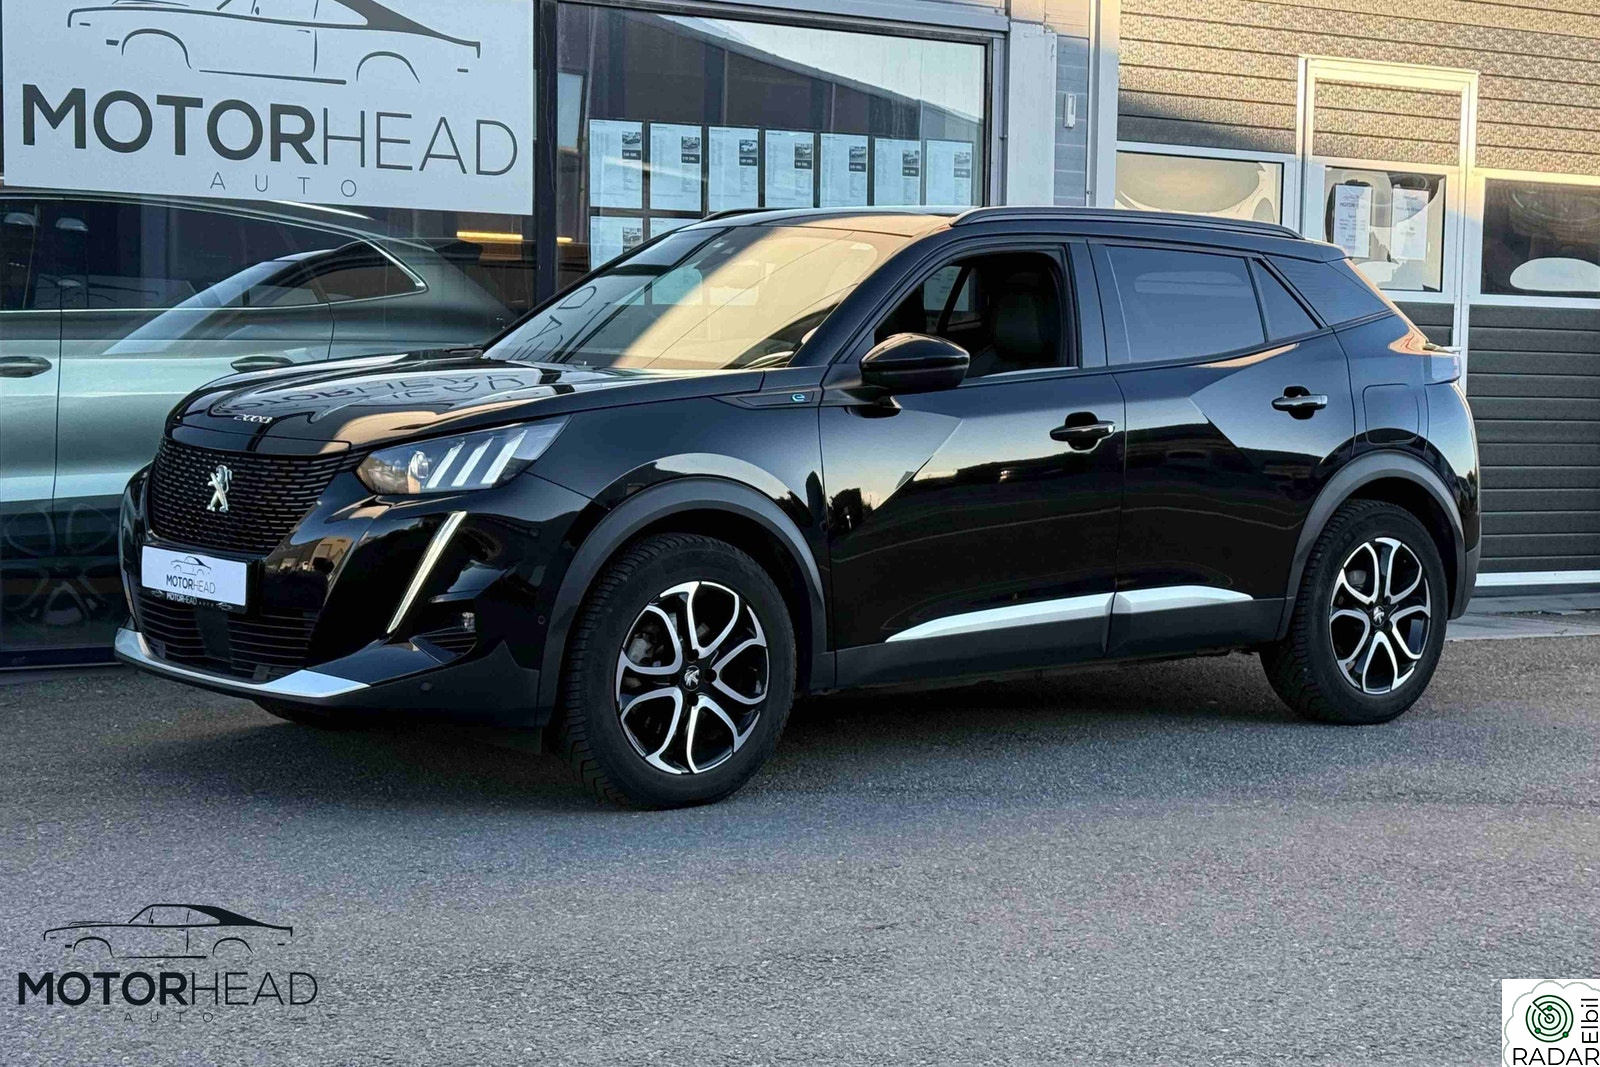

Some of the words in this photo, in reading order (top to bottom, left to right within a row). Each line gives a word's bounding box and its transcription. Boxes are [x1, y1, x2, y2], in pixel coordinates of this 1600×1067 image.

[22, 83, 518, 177] MOTORHEAD
[209, 171, 358, 198] AUTO
[234, 413, 273, 424] 2008
[166, 574, 216, 595] MOTORHEAD
